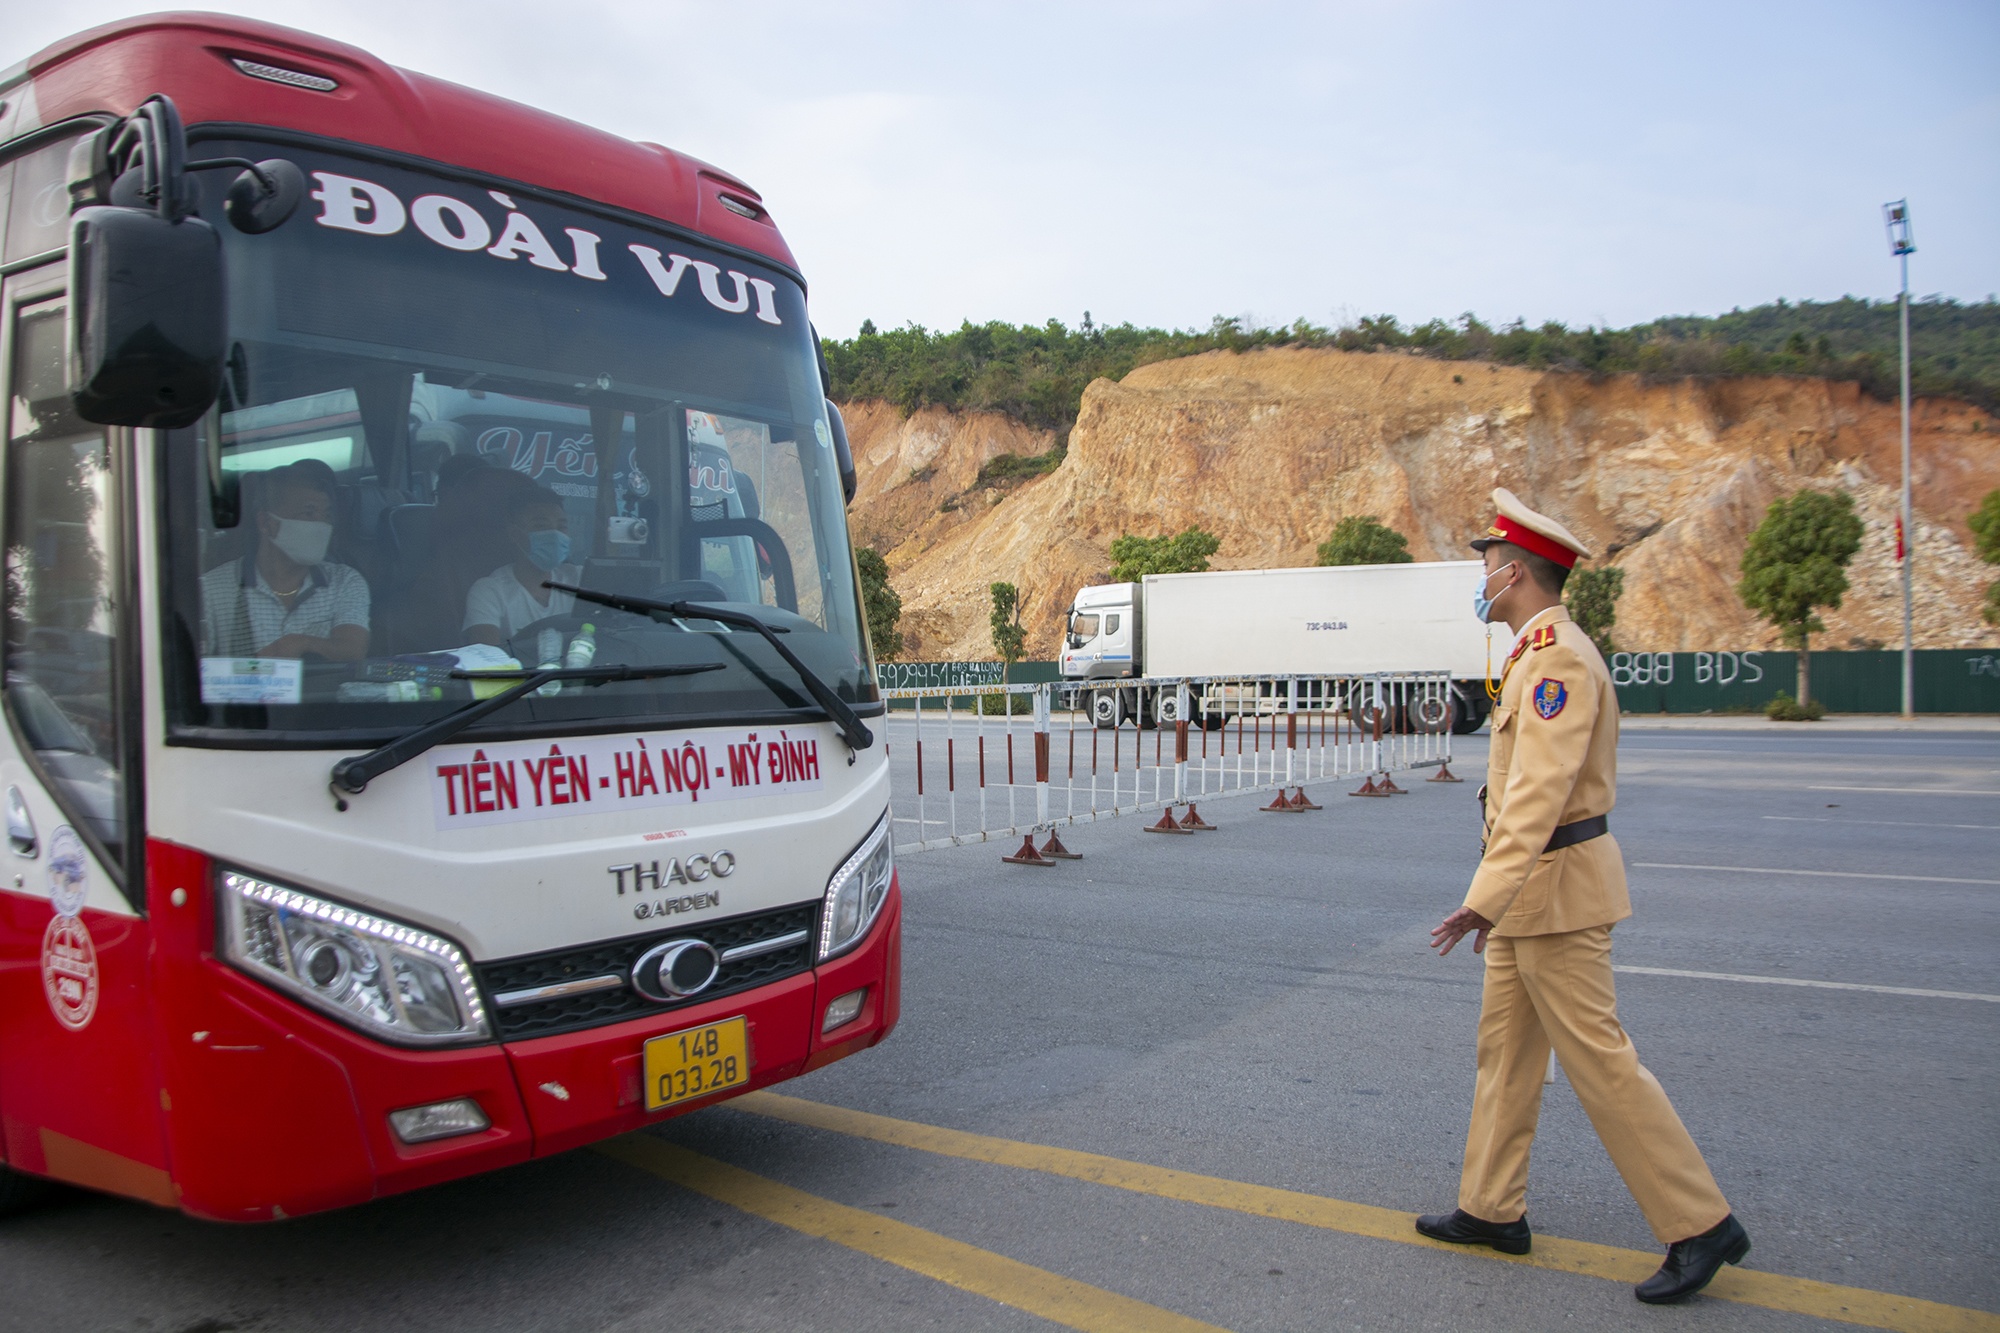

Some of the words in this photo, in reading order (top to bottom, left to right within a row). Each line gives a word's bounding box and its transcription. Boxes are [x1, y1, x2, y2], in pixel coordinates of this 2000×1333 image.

[310, 171, 607, 280] ĐOÀI
[628, 243, 782, 325] VUI
[944, 687, 971, 696] GIAO
[437, 749, 518, 815] TIÊN
[524, 744, 591, 807] YÊN
[614, 738, 659, 798] HÀ
[662, 740, 710, 802] NỘI
[727, 733, 761, 787] MỸ
[768, 730, 820, 784] ĐÌNH
[608, 849, 736, 896] THACO
[634, 890, 720, 920] GARDEN
[678, 1029, 719, 1063] 14B
[658, 1055, 737, 1101] 033.28
